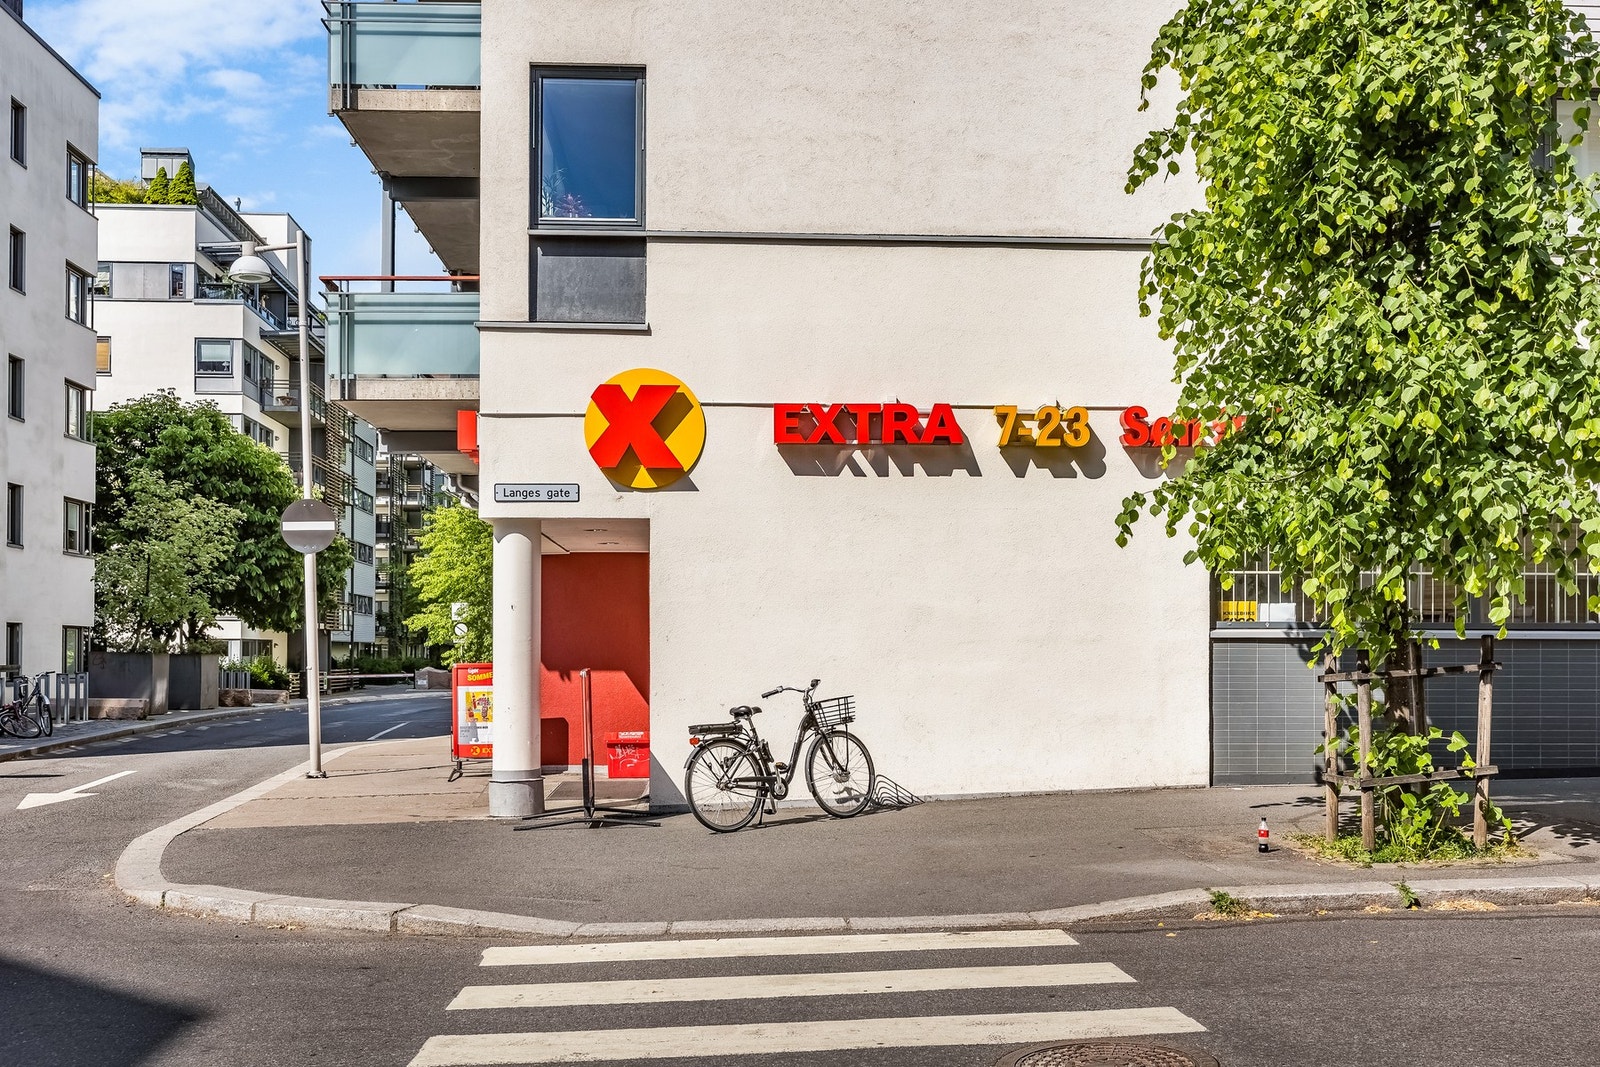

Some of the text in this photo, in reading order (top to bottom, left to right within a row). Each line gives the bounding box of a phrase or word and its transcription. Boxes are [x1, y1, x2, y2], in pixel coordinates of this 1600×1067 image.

[588, 384, 684, 469] X
[773, 403, 964, 445] EXTRA
[993, 405, 1091, 448] 7-23
[503, 487, 571, 500] Langes gate
